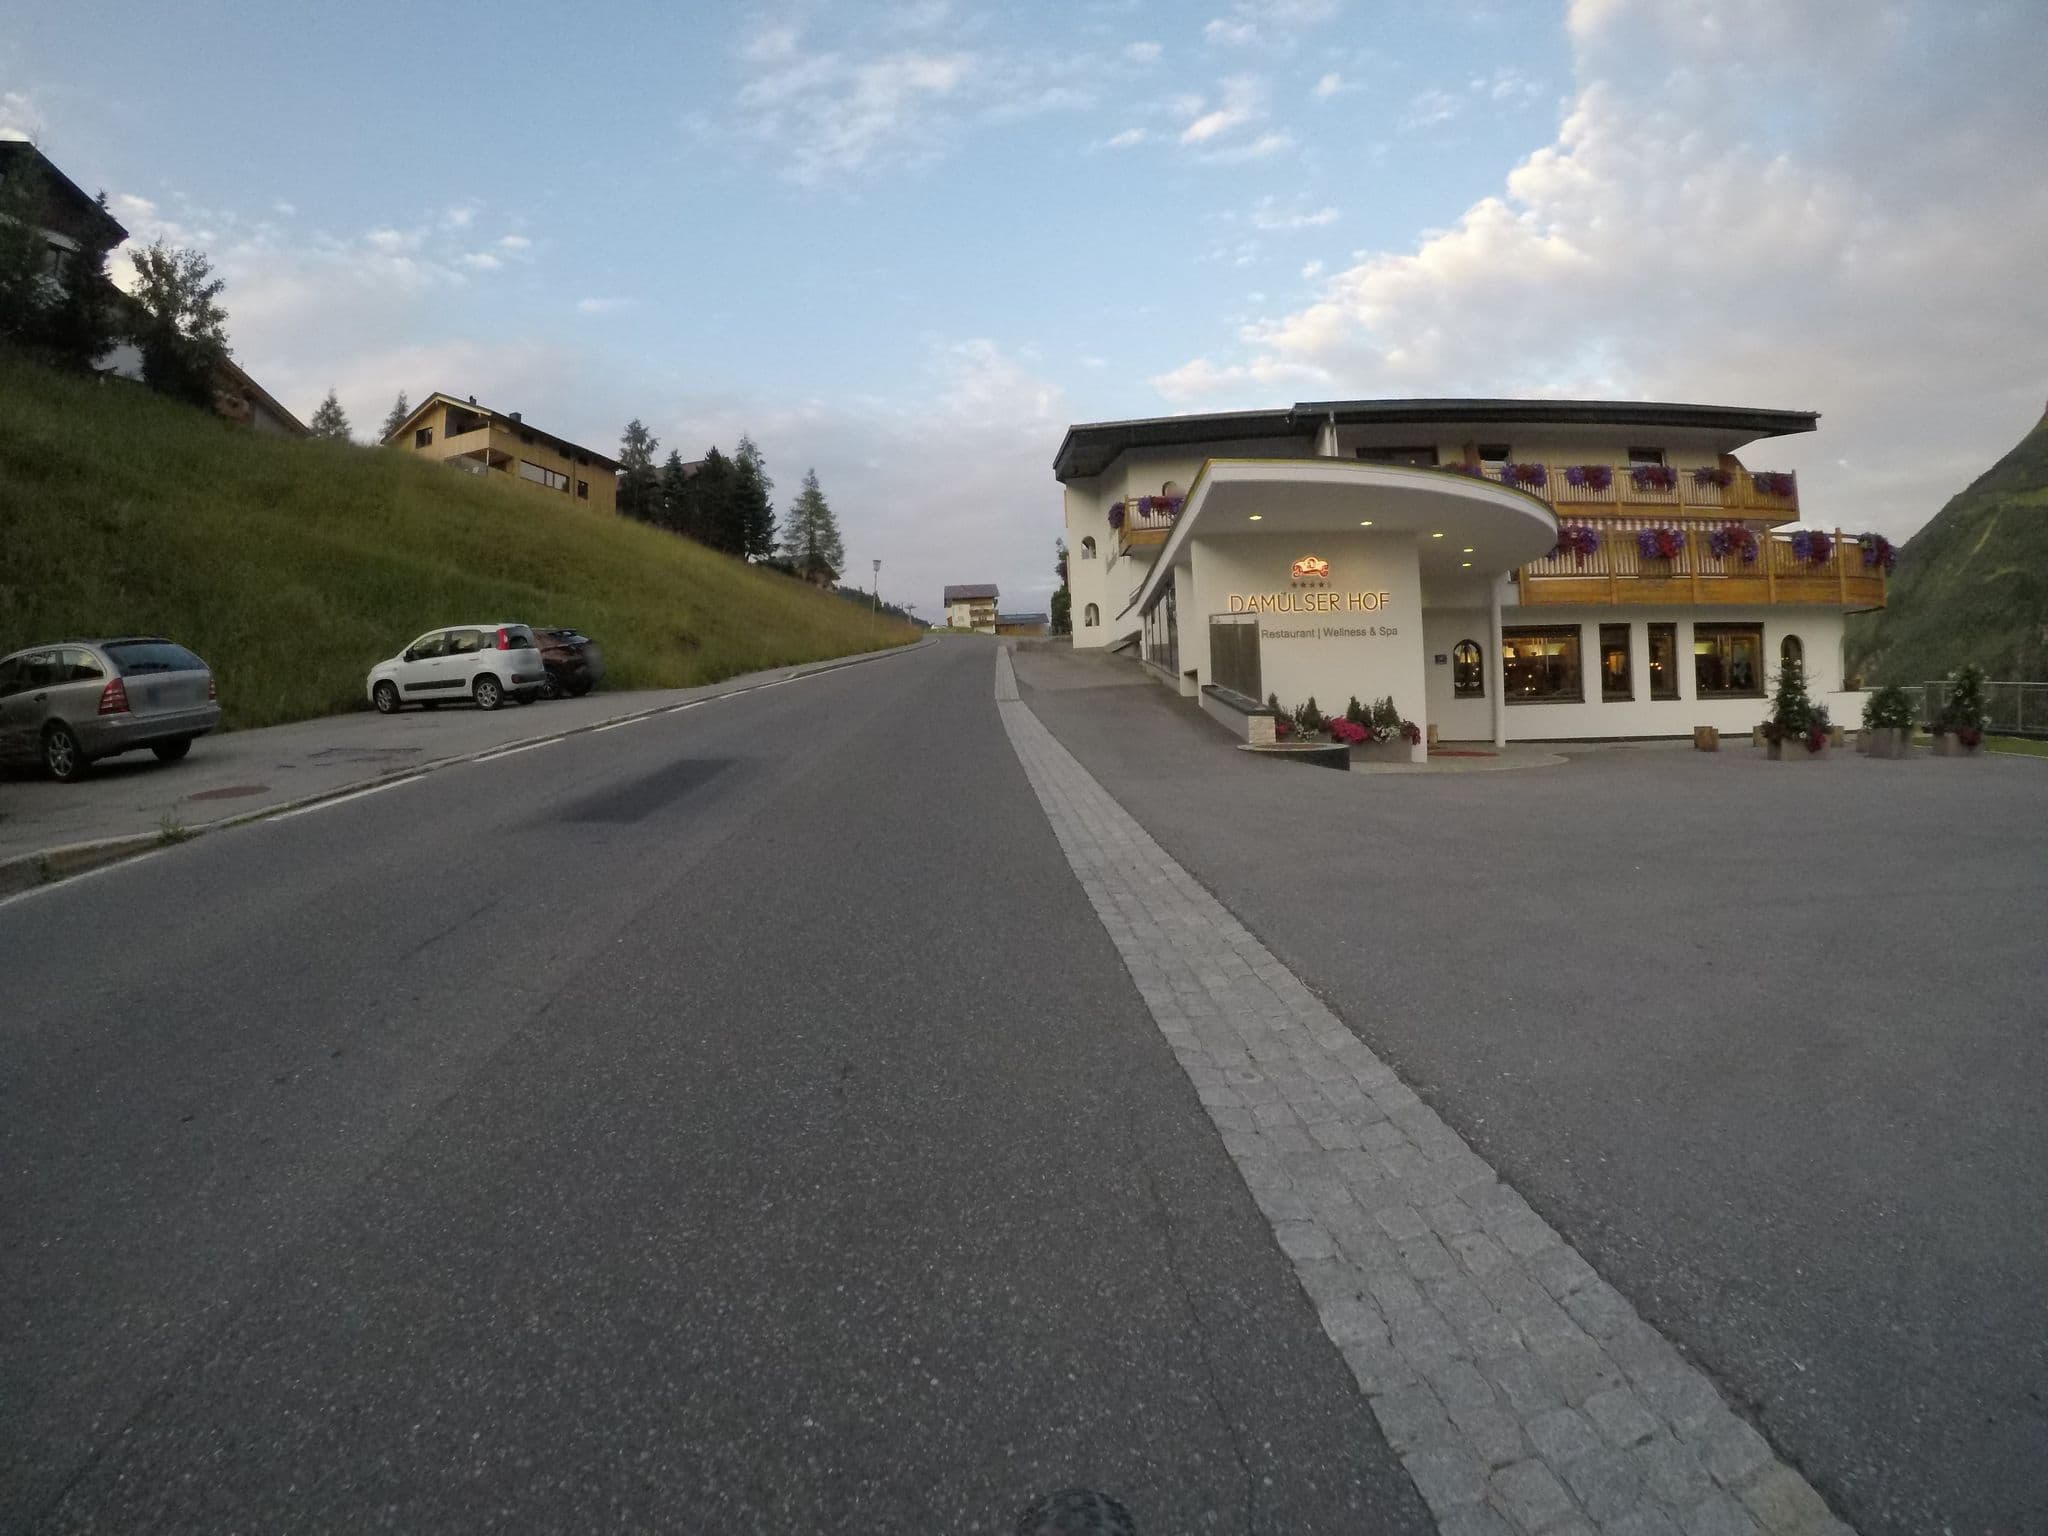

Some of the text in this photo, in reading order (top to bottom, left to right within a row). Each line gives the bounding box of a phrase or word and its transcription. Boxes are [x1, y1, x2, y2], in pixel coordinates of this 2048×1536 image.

[1230, 591, 1390, 612] DAMÜLSER HOF
[1261, 629, 1315, 639] Restaurant
[1322, 627, 1367, 638] Wellness
[1369, 626, 1377, 637] &
[1379, 626, 1398, 638] Spa
